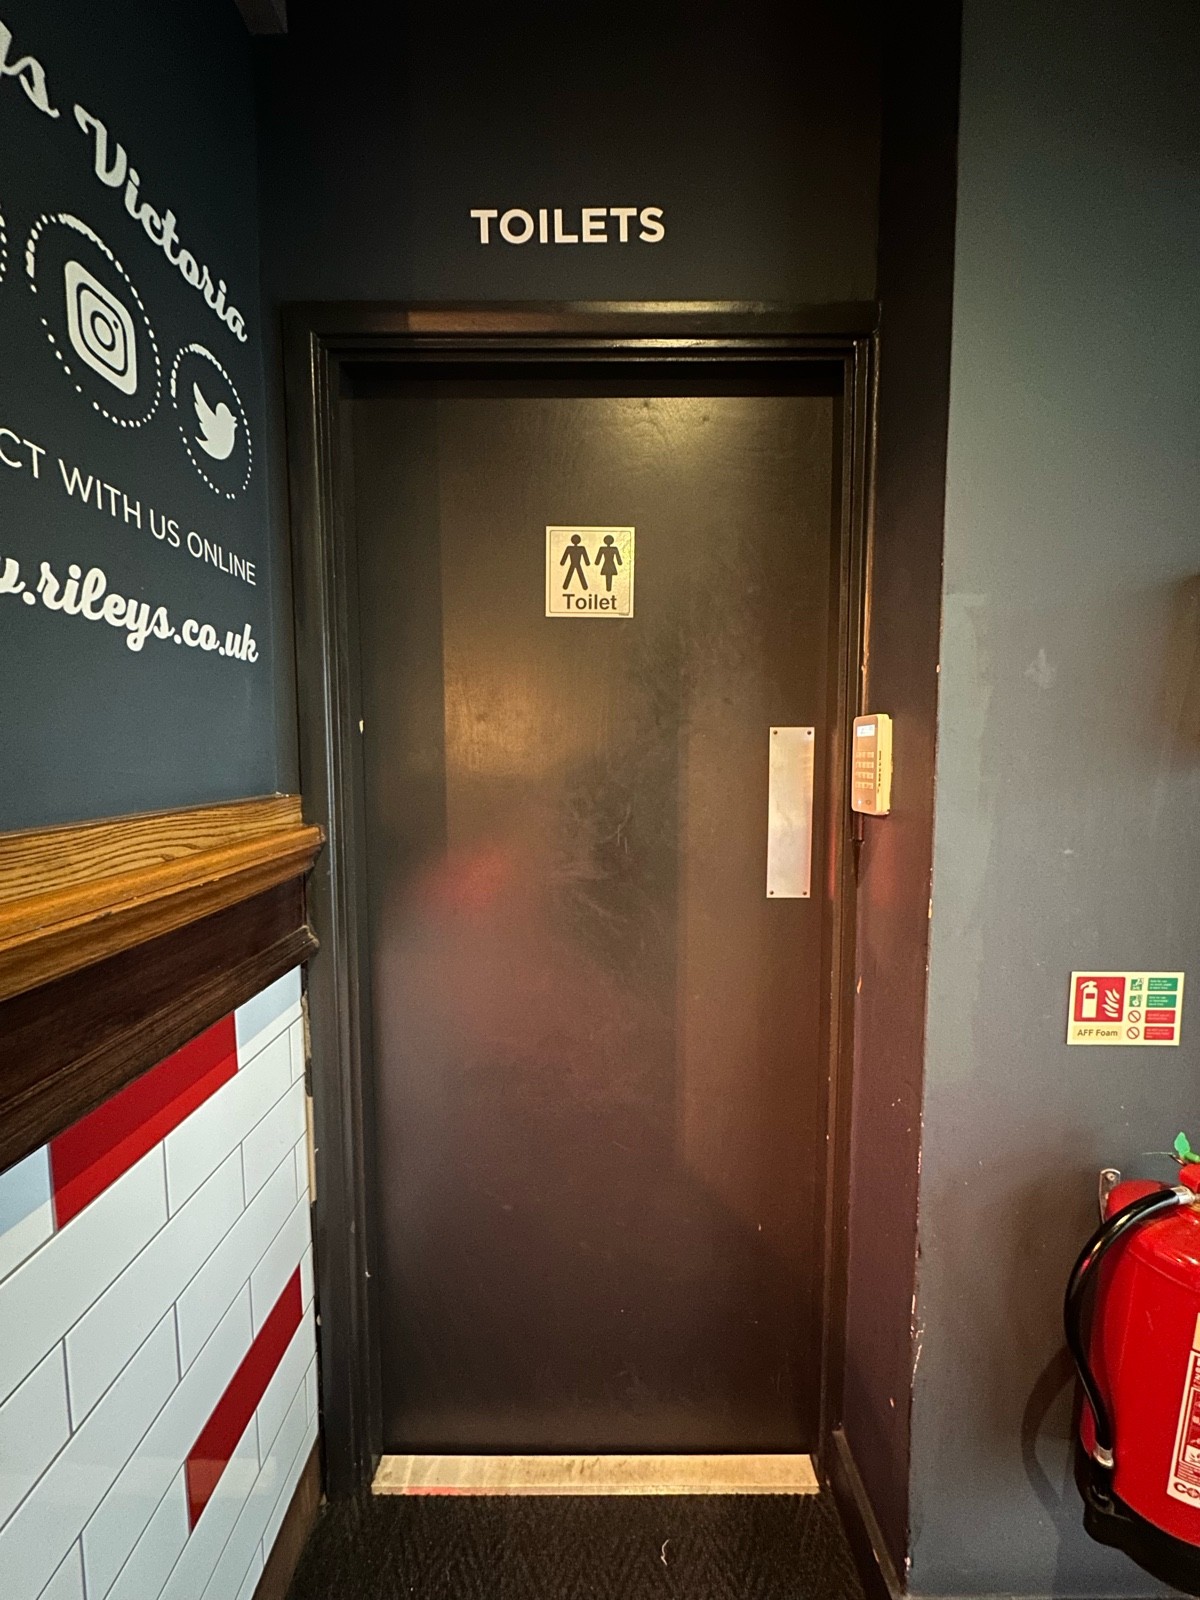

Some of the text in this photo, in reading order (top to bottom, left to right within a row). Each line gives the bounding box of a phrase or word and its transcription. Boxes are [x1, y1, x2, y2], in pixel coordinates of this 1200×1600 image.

[73, 104, 248, 342] Victoria
[470, 206, 665, 244] TOILETS
[58, 458, 142, 529] WITH
[150, 508, 181, 548] US
[187, 531, 257, 586] ONLINE
[562, 593, 617, 610] Toilet
[1077, 1028, 1119, 1037] AFF Foam
